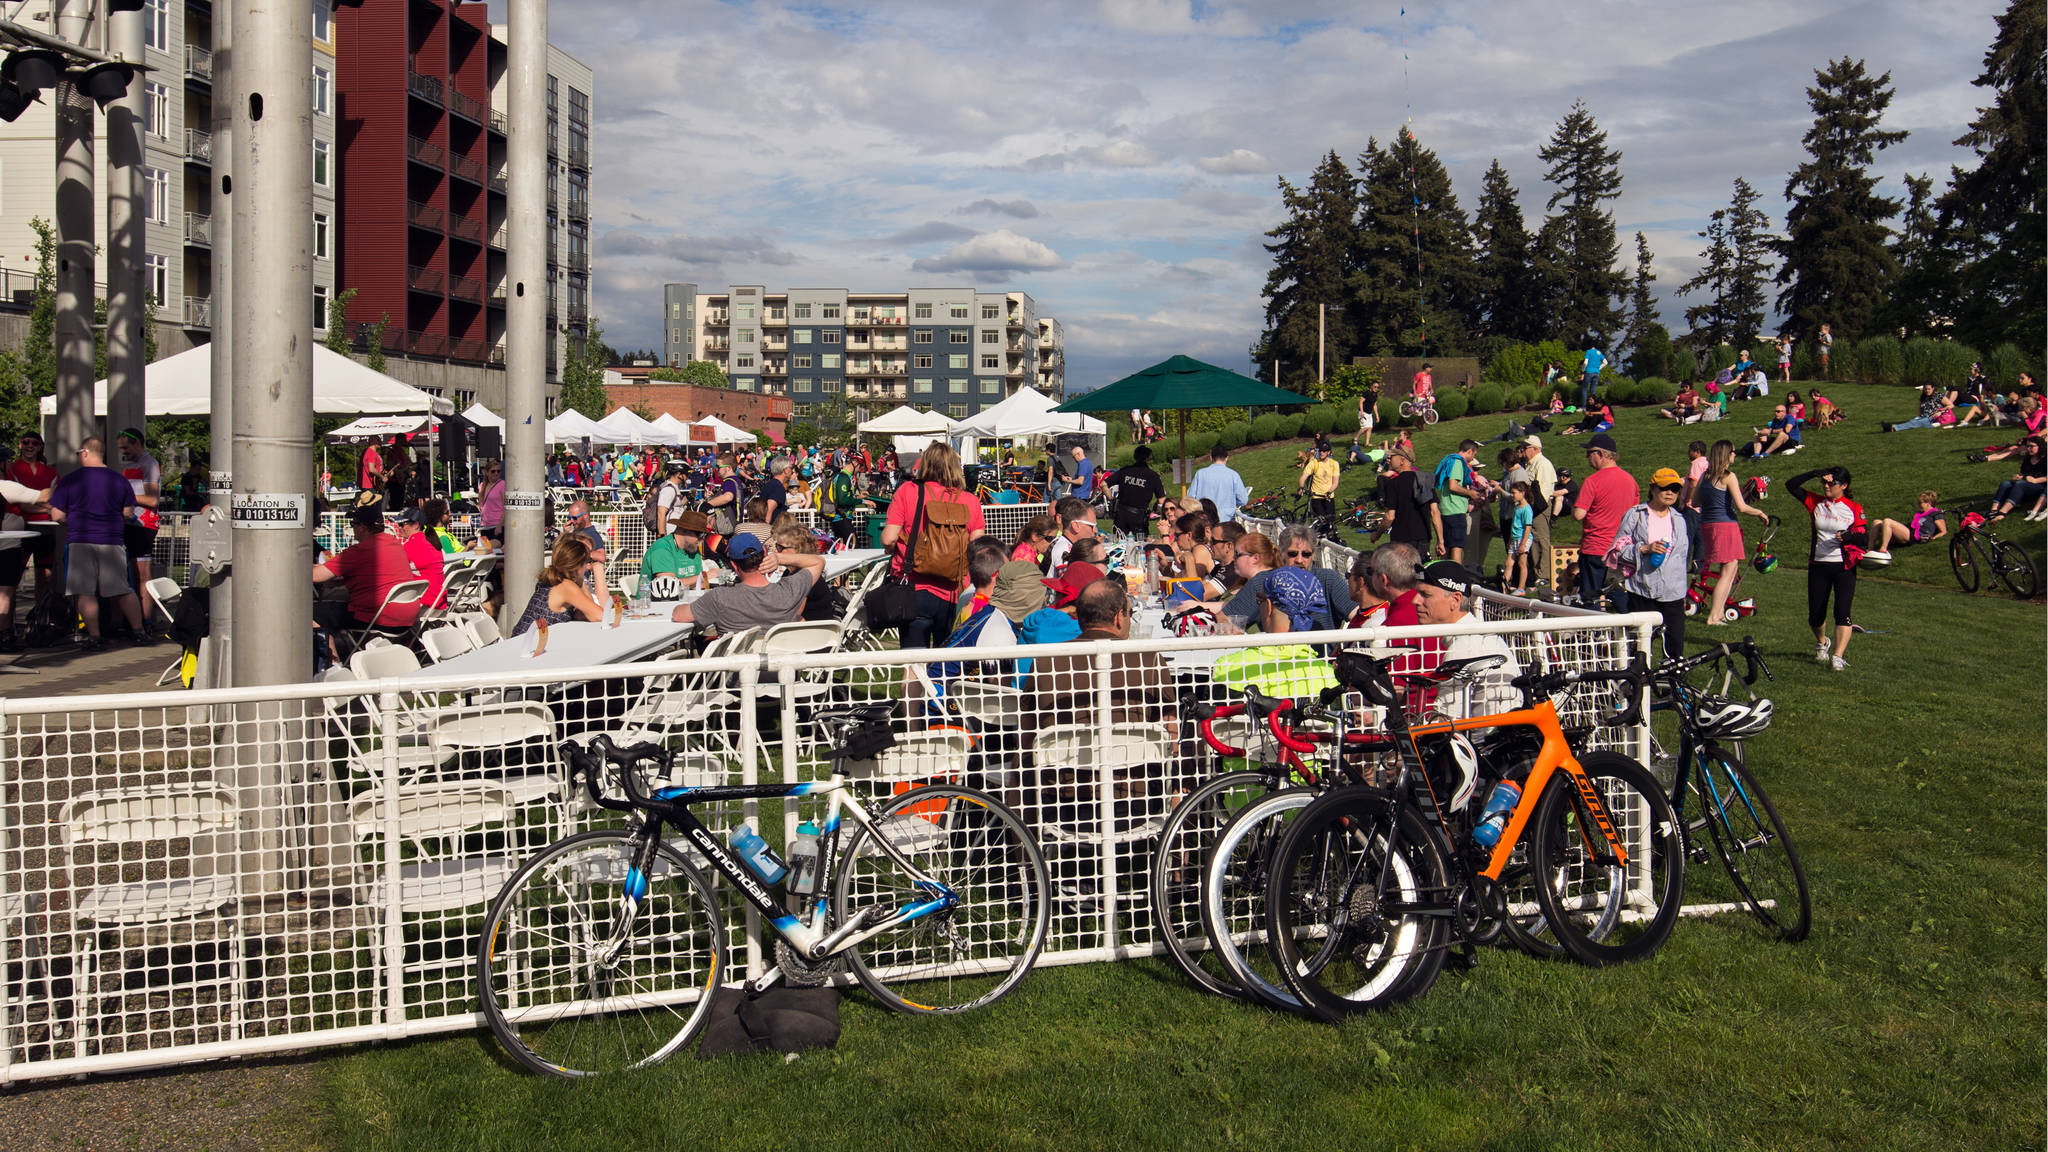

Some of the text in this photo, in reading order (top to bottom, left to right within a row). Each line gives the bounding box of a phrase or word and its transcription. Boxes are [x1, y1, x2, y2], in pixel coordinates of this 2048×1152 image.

[1124, 476, 1147, 488] POLICE
[246, 509, 297, 520] 0101319K
[1575, 773, 1624, 850] GIANT
[692, 828, 773, 909] cannondale
[822, 837, 834, 892] cannondale
